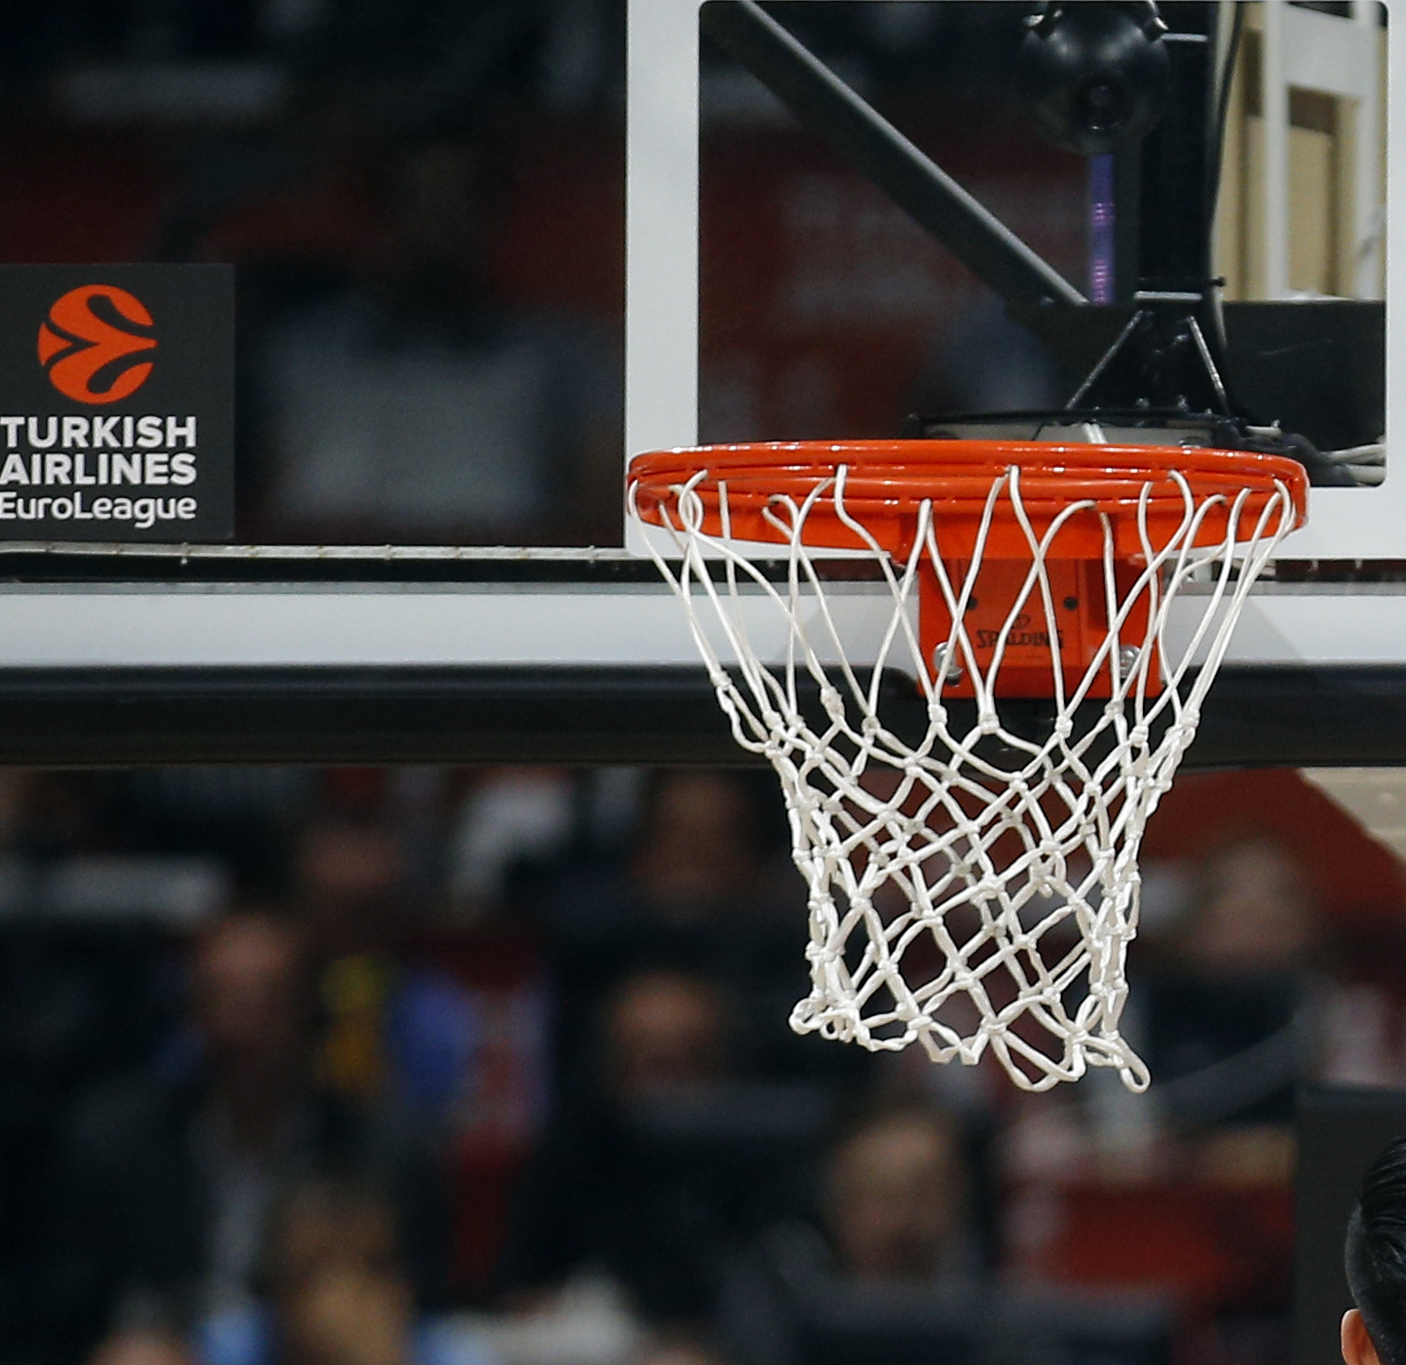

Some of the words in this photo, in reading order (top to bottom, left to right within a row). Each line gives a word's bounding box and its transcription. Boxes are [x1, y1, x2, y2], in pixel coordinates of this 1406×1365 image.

[0, 416, 197, 448] TURKISH
[0, 453, 197, 485] AIRLINES
[0, 491, 197, 529] EuroLeague
